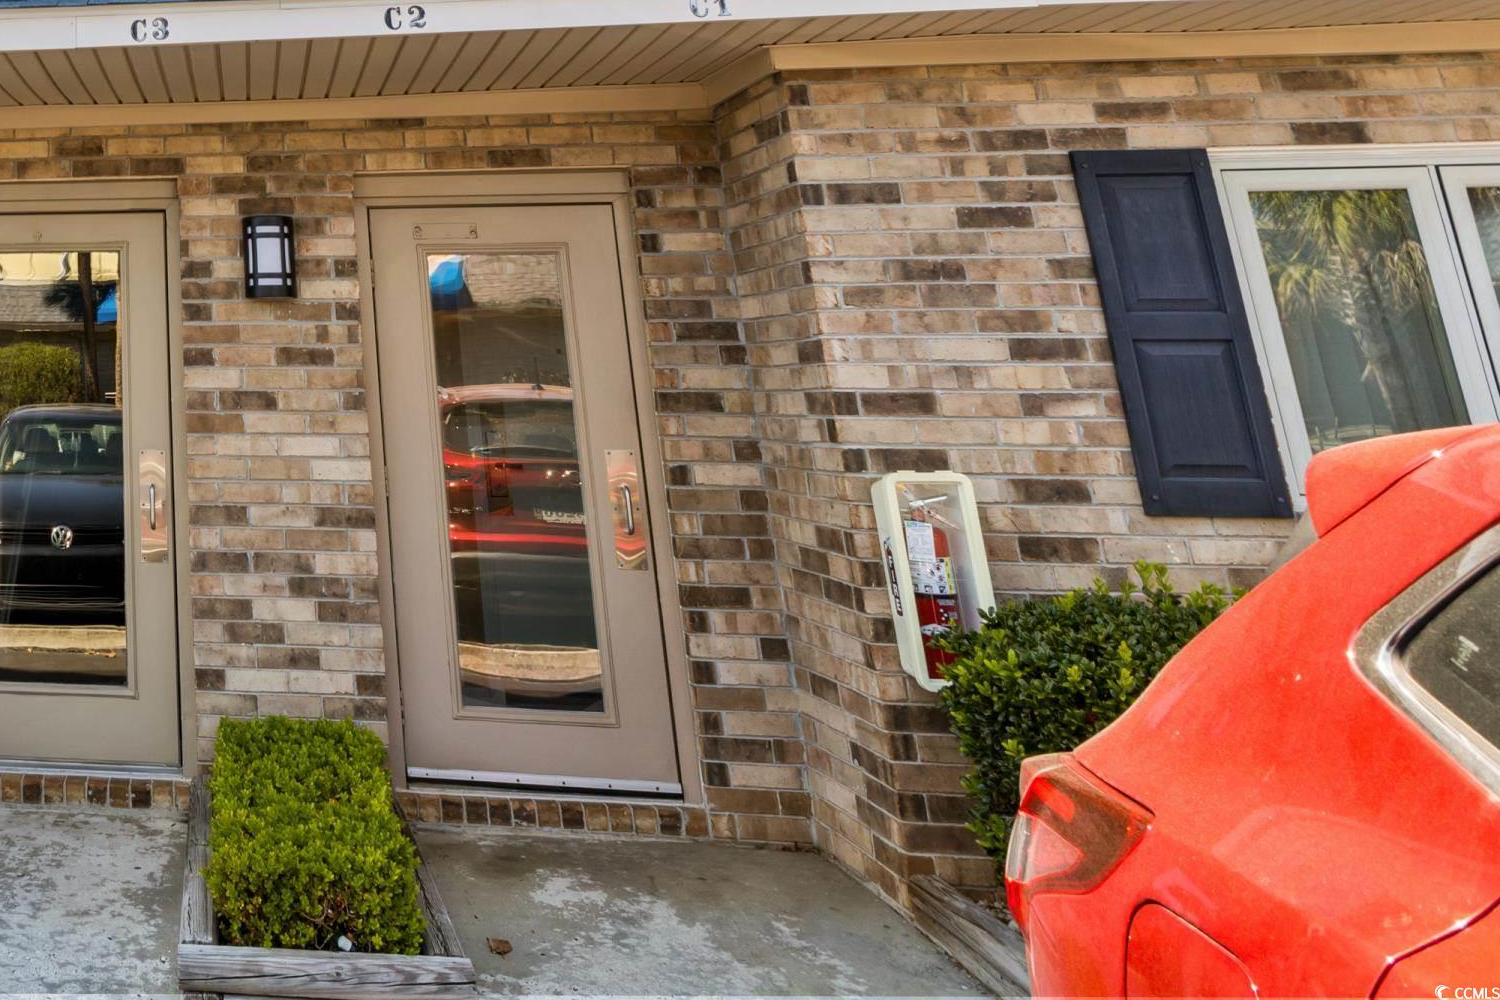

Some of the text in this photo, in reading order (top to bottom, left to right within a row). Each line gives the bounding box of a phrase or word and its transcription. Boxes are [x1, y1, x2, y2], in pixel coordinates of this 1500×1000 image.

[130, 17, 170, 42] C3
[384, 5, 427, 31] C2
[886, 554, 903, 612] FIRE
